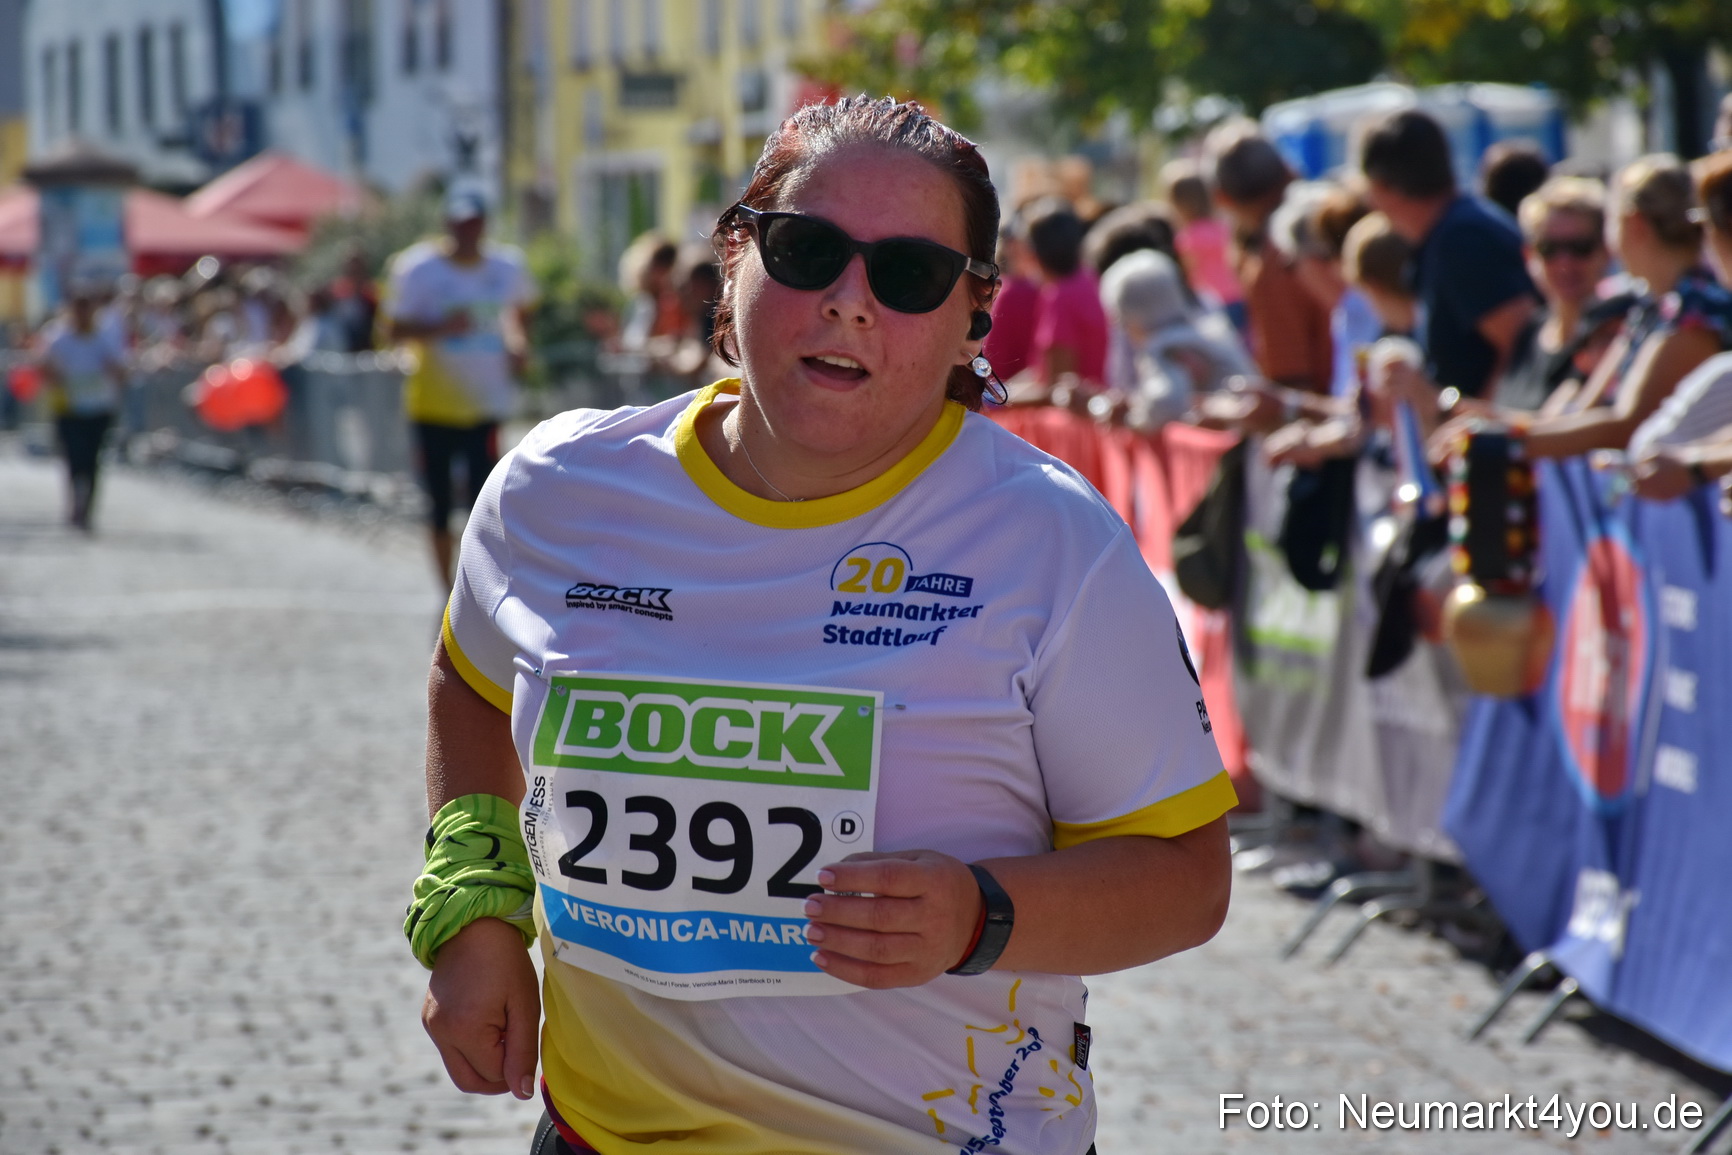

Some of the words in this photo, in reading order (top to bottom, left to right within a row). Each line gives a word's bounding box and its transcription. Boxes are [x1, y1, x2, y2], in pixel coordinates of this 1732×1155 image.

[837, 557, 905, 594] 20
[909, 576, 967, 594] JAHRE
[566, 600, 595, 610] inspired
[596, 601, 606, 611] by
[608, 602, 633, 614] smart
[634, 607, 673, 621] concepts
[830, 600, 984, 622] Neumarkter
[822, 623, 948, 647] Stadtlauf
[554, 689, 845, 777] BOCK
[558, 790, 825, 900] 2392
[840, 818, 856, 835] D
[562, 897, 808, 946] VERONICA-MAR
[982, 1058, 1020, 1146] Septmber
